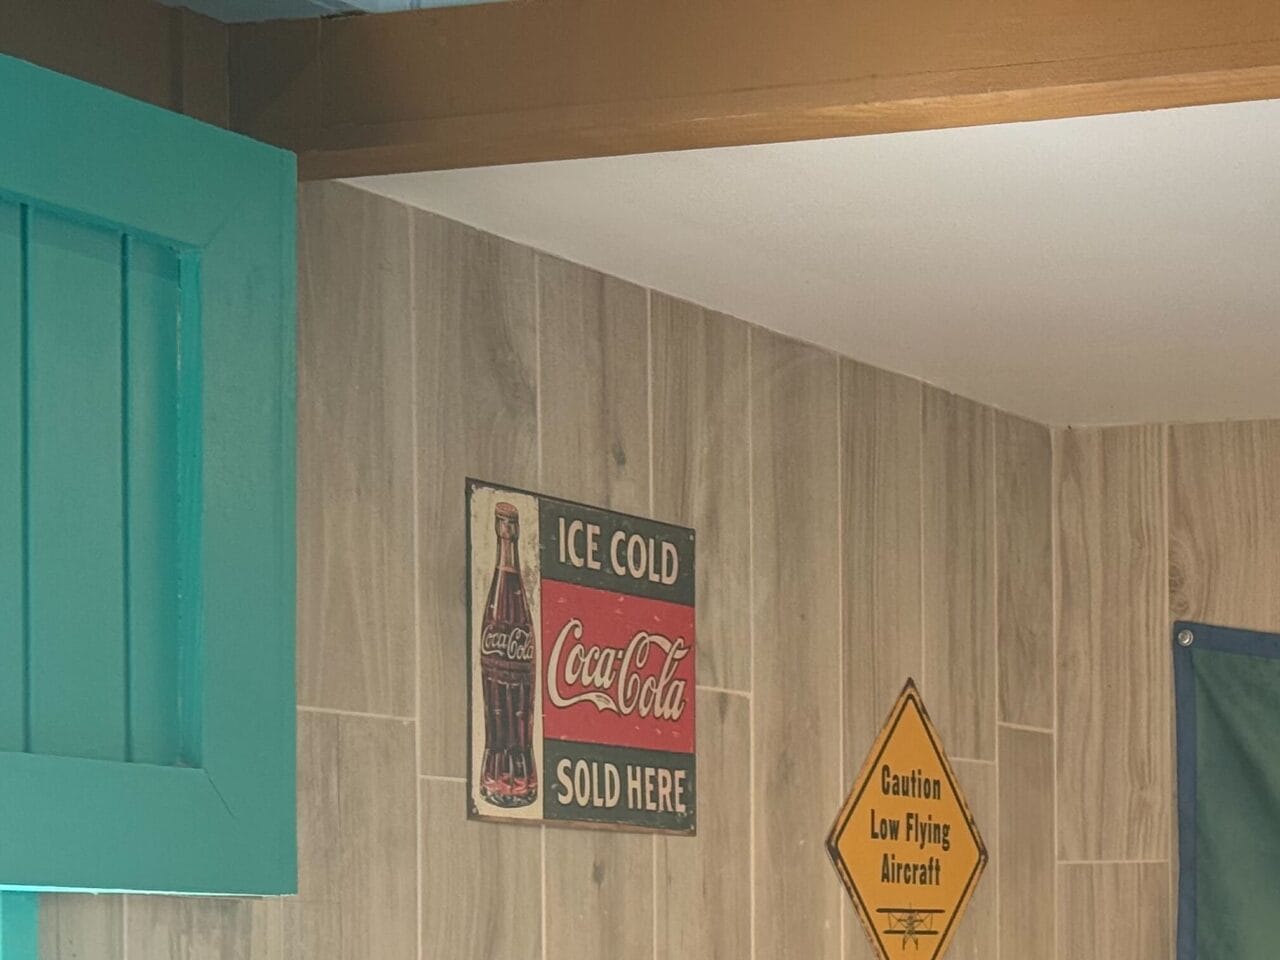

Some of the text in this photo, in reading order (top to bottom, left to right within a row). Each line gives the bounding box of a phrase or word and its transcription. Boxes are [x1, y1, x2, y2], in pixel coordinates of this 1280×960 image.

[558, 516, 680, 585] ICE COLD
[547, 617, 691, 720] Coca-Cola
[556, 758, 687, 812] SOLD HERE
[881, 764, 941, 800] Caution
[870, 809, 951, 851] Low Flying
[881, 853, 941, 886] Aircraft
